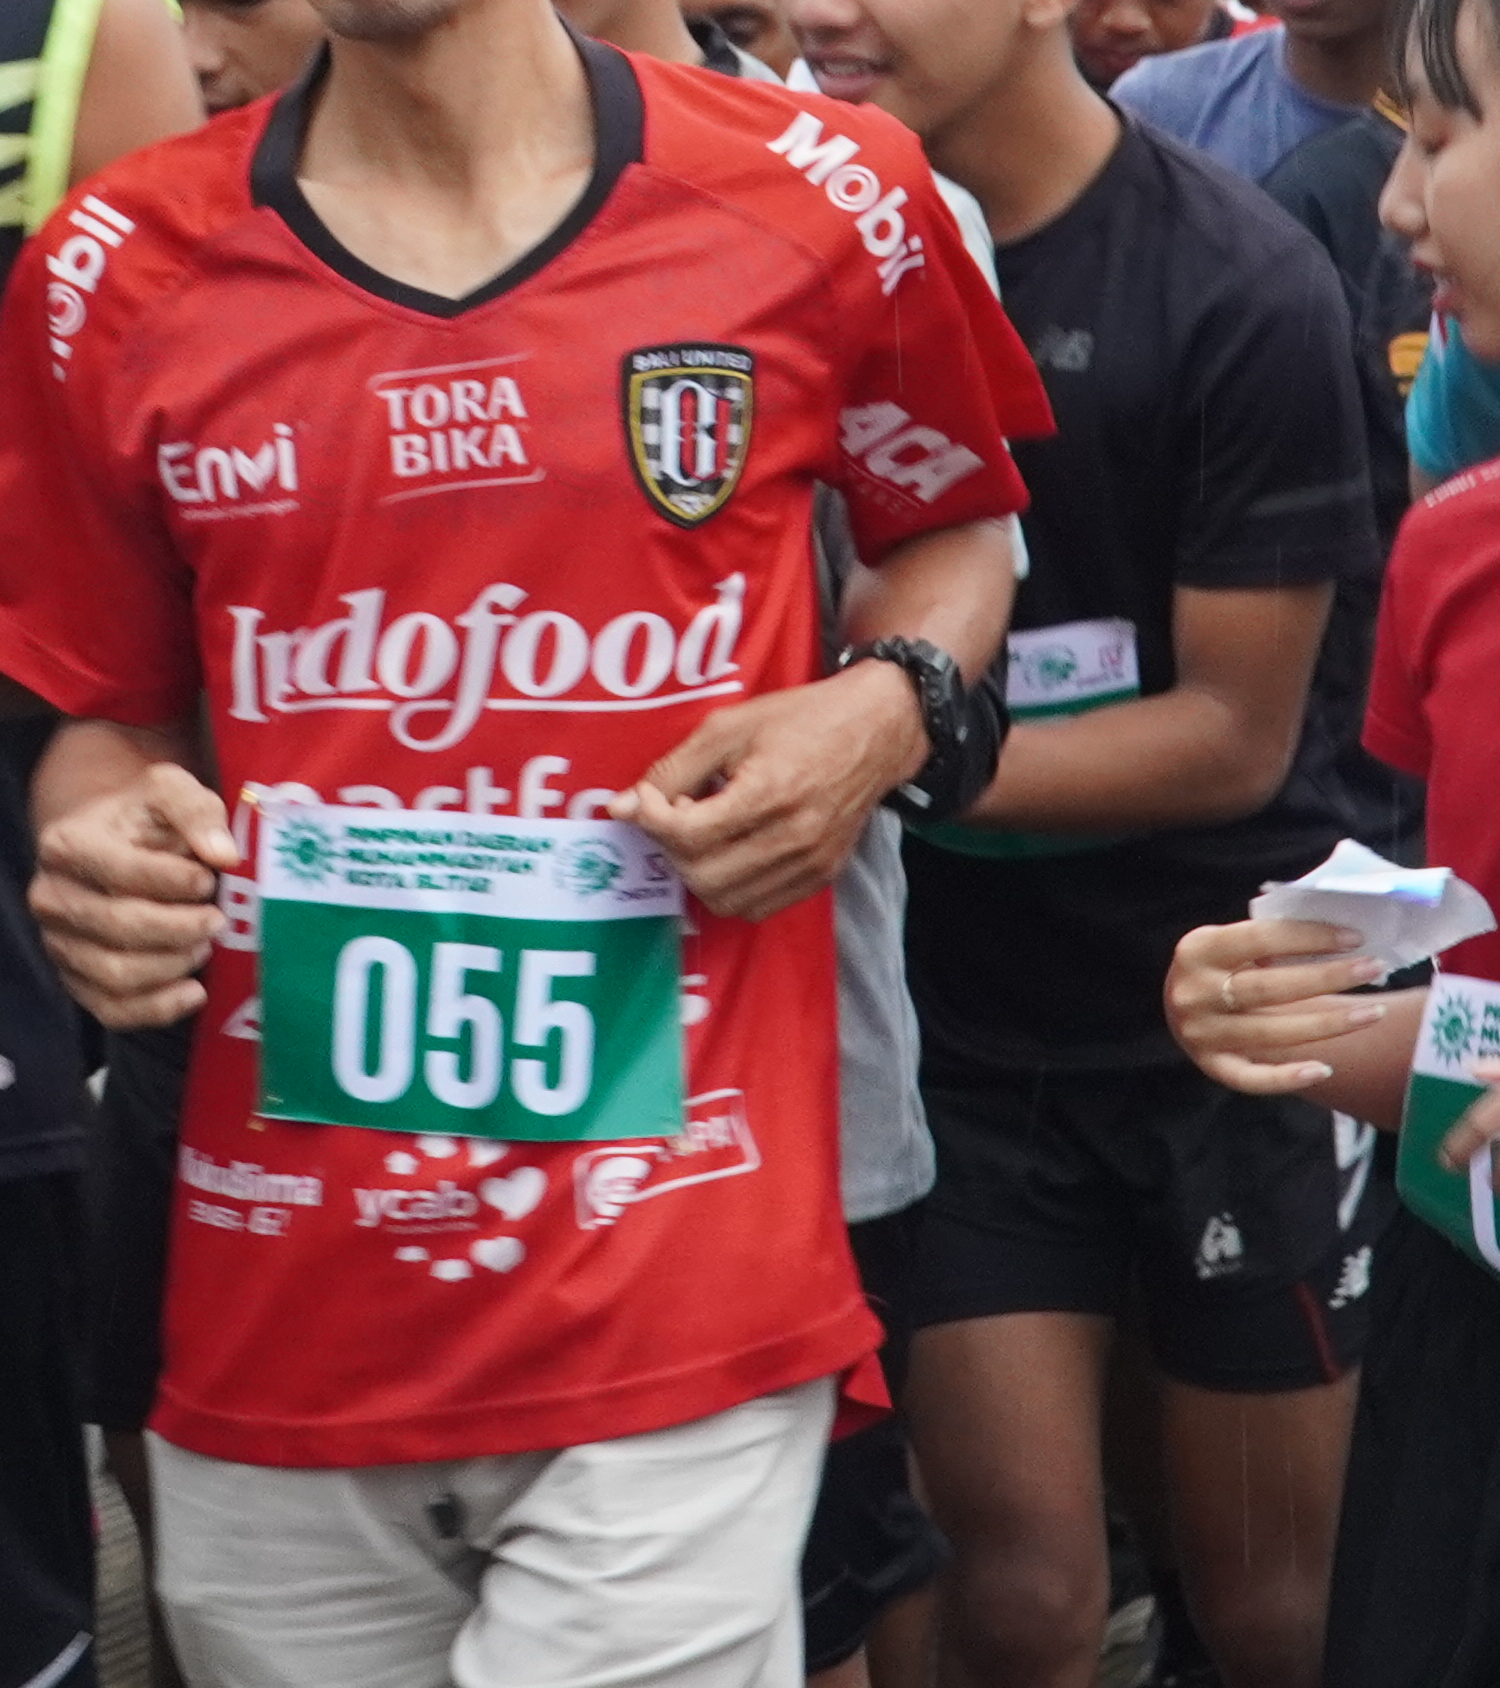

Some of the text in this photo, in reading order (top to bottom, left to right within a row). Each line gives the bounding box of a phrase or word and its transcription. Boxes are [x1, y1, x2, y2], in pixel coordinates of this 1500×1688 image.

[45, 193, 136, 383] obil
[766, 110, 926, 297] Mobil
[376, 376, 528, 431] TORA
[389, 423, 528, 478] BIKA
[227, 573, 745, 750] Indofood
[331, 934, 597, 1118] 055
